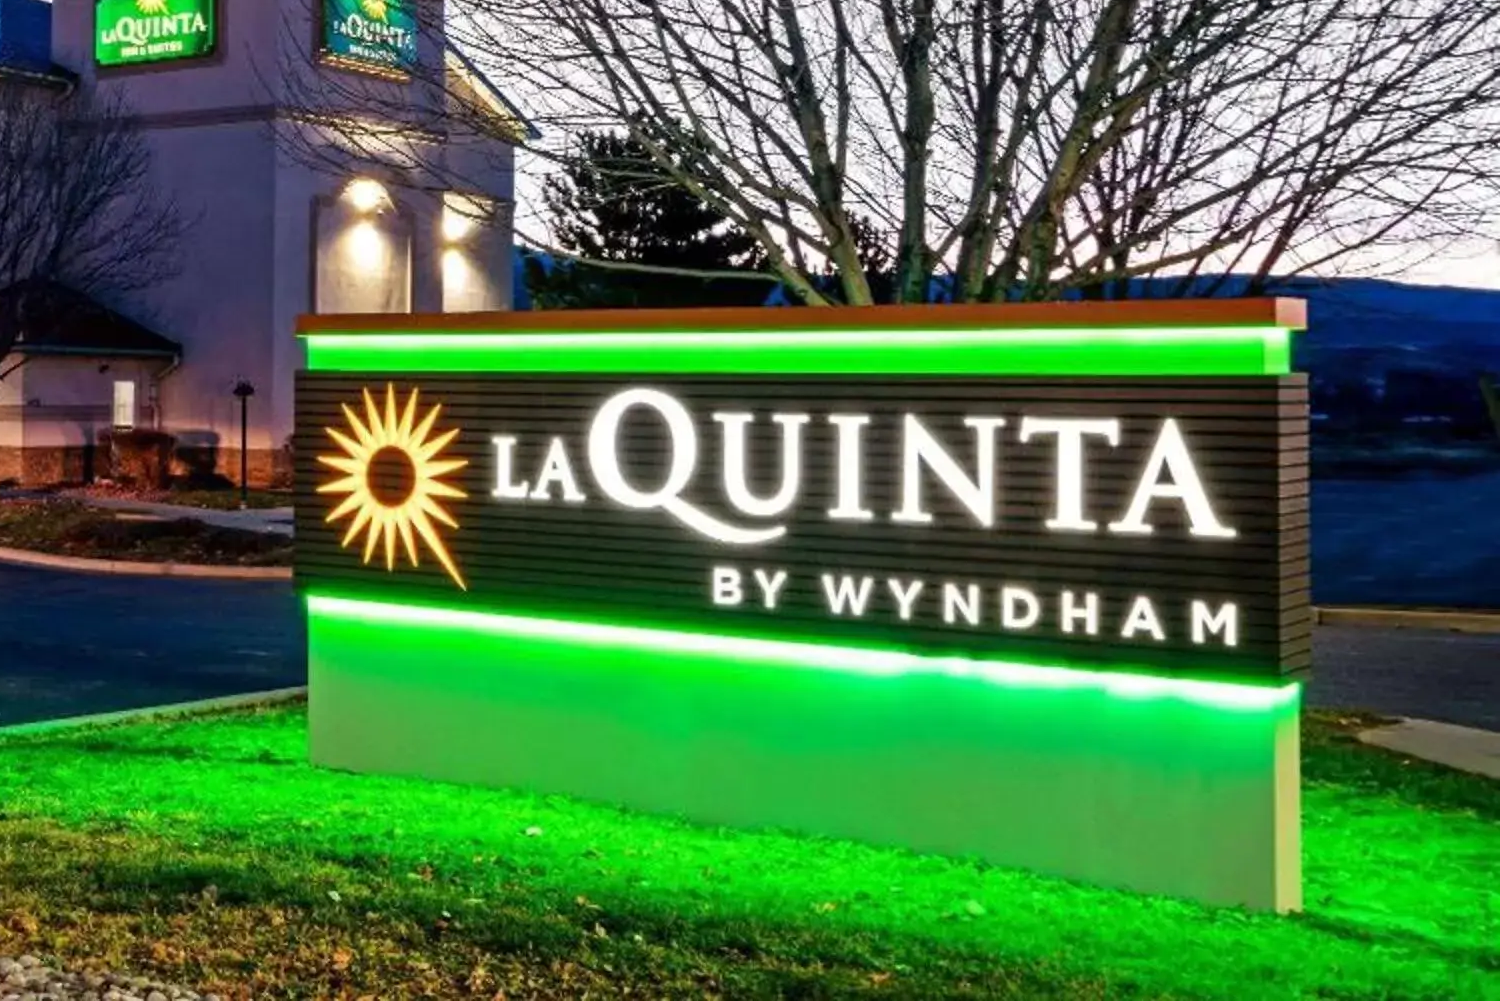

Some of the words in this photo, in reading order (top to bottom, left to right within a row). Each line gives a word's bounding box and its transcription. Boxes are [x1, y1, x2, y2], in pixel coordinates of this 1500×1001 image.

[101, 29, 118, 45] LA
[116, 12, 208, 46] QUINTA
[492, 436, 586, 502] LA
[588, 388, 1237, 544] QUINTA
[713, 566, 788, 609] BY
[822, 573, 1238, 647] WYNDHAM
